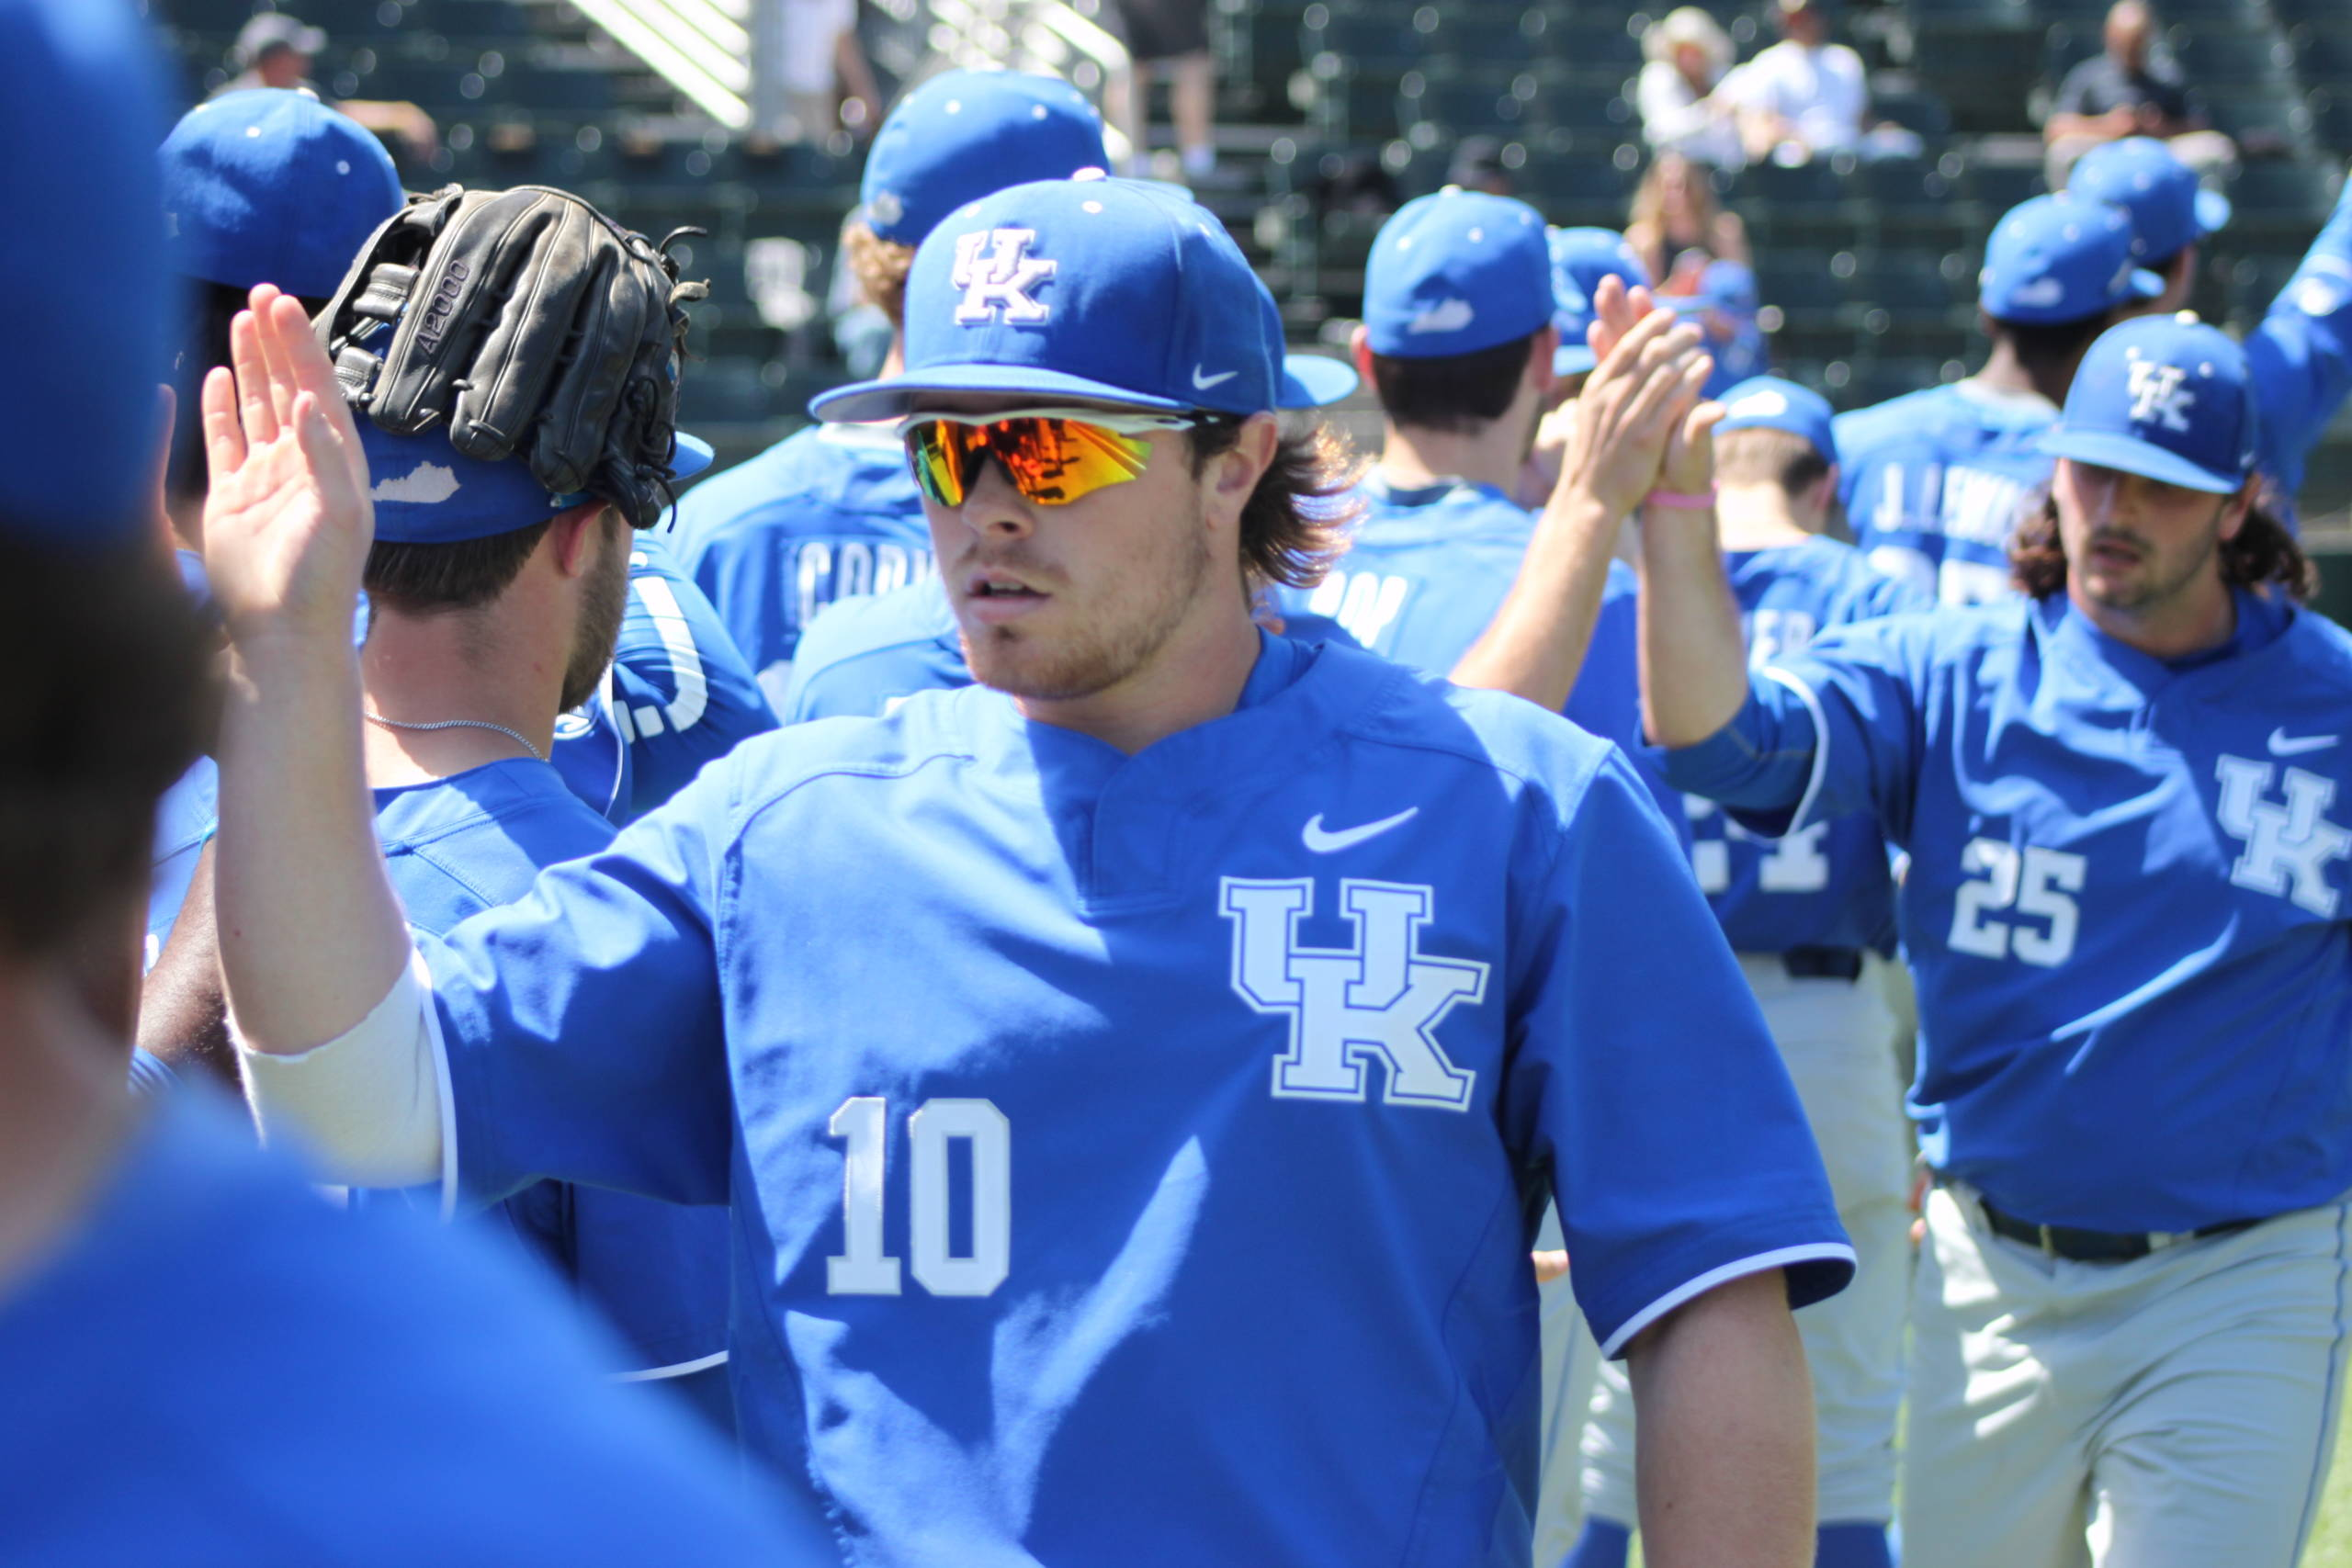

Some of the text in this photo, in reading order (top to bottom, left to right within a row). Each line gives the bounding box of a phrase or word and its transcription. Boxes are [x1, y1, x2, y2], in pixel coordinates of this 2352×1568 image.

[415, 259, 469, 355] A2000
[951, 228, 1057, 325] UK
[2127, 361, 2195, 433] UK
[2215, 753, 2352, 919] UK
[1947, 837, 2086, 967] 25
[1218, 875, 1490, 1112] UK
[827, 1096, 1010, 1297] 10
